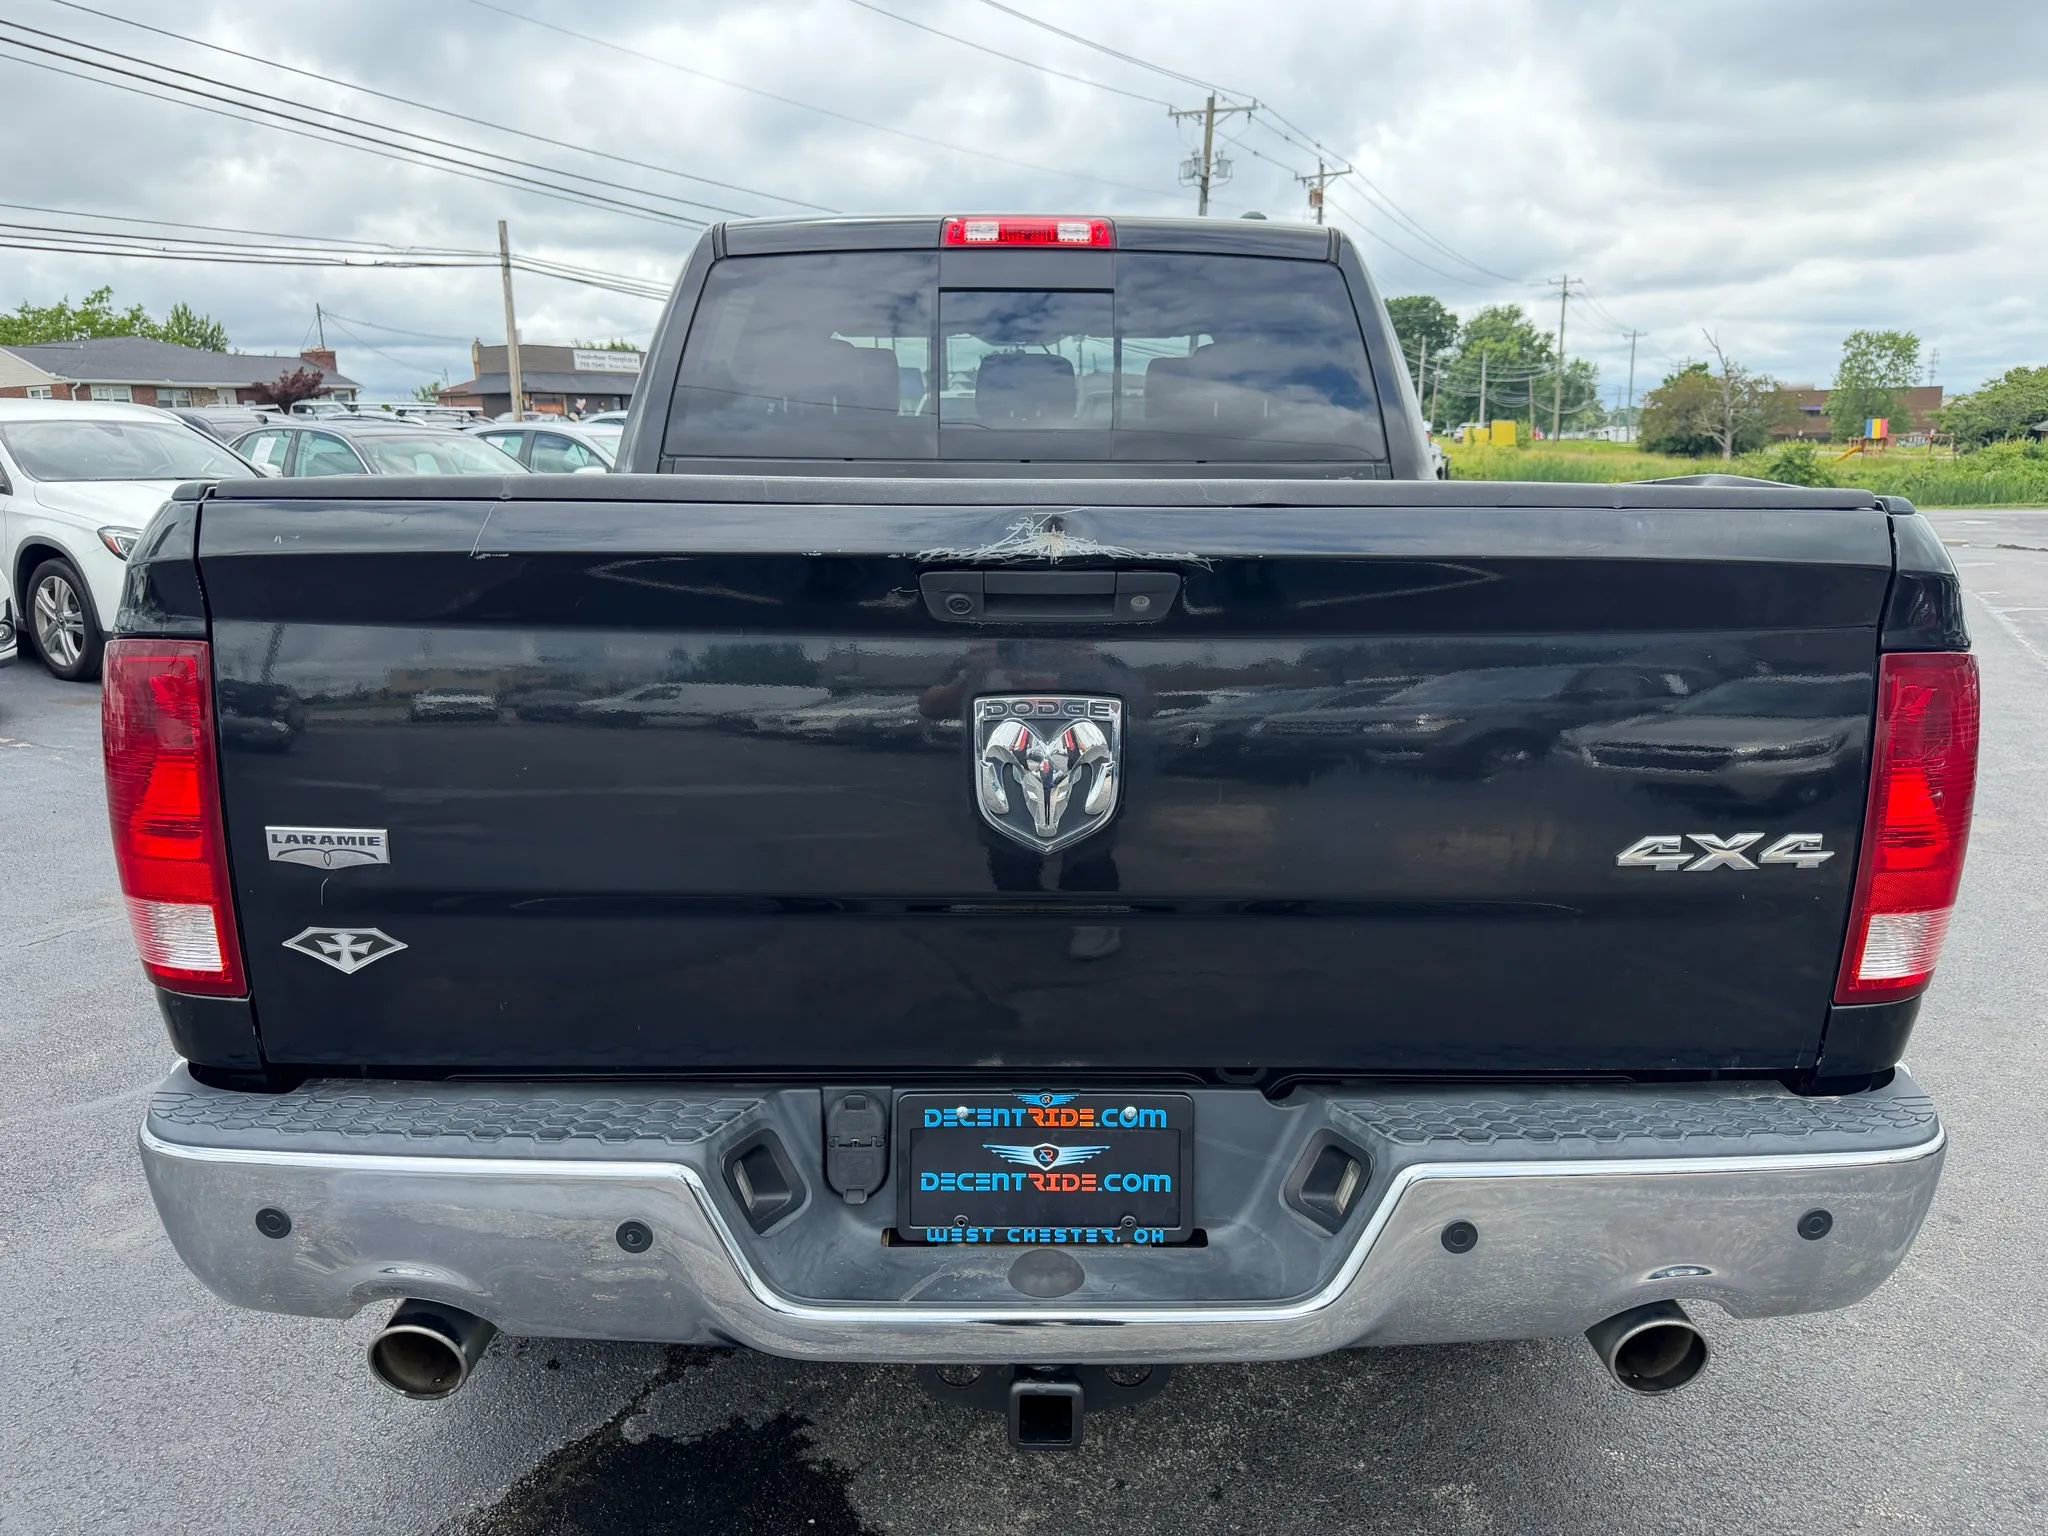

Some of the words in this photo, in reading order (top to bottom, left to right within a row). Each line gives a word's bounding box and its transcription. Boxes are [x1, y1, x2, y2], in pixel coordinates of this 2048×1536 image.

[984, 701, 1111, 717] DODGE
[271, 833, 381, 846] LARAMIE
[926, 1228, 994, 1242] WEST
[1007, 1228, 1121, 1243] CHESTER,
[1133, 1229, 1165, 1243] OH
